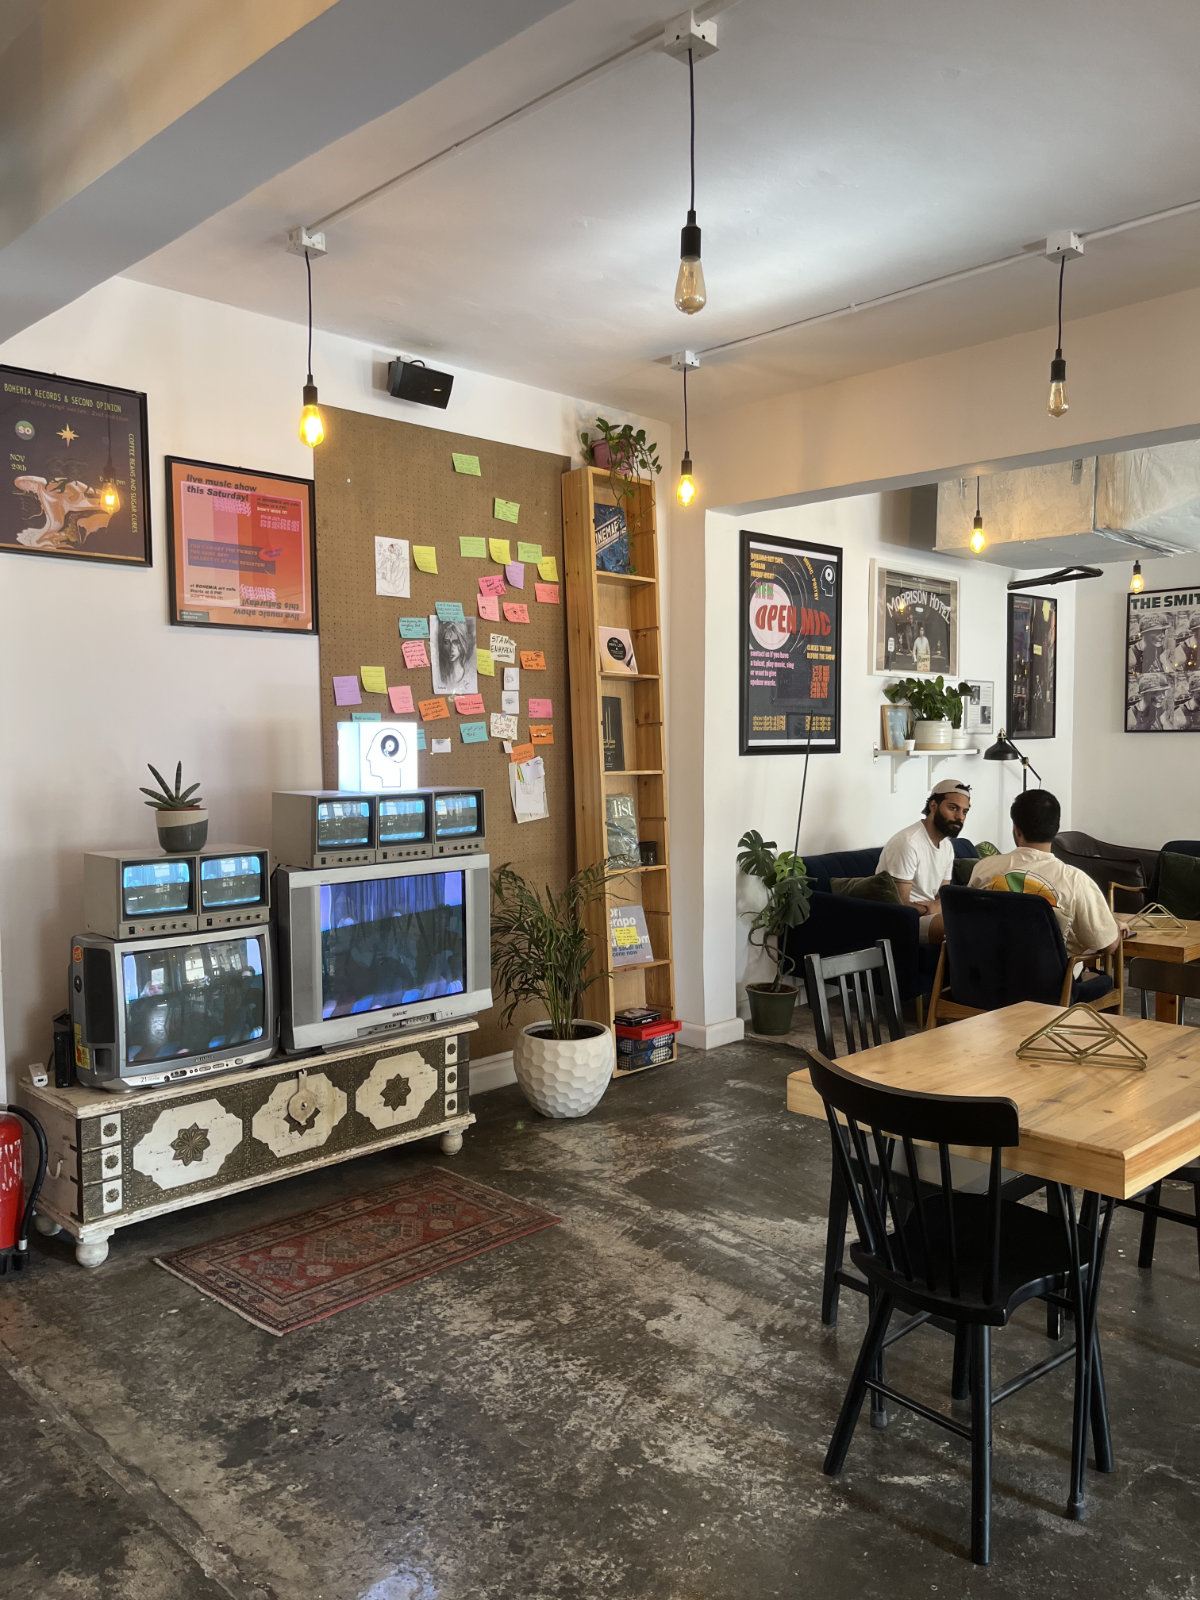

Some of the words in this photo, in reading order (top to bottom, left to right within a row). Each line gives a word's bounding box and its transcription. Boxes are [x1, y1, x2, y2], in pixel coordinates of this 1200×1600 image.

[4, 383, 31, 396] BOHEMIA
[34, 389, 61, 401] RECORDS
[71, 396, 93, 407] SECOND
[96, 401, 121, 413] OPINION
[18, 425, 32, 435] SO
[10, 453, 25, 462] NOV
[187, 474, 202, 483] live
[205, 478, 232, 488] music
[234, 483, 256, 492] show
[187, 485, 204, 494] this
[207, 488, 249, 502] Saturday!
[242, 598, 281, 609] Saturday!
[284, 602, 299, 610] this
[887, 590, 928, 618] MORRISON
[929, 592, 951, 625] HOTEL
[1131, 597, 1161, 610] THE
[233, 608, 256, 616] show
[258, 610, 283, 618] music
[285, 612, 299, 620] live
[755, 604, 797, 635] OPEN
[801, 607, 831, 636] MIC
[613, 799, 633, 817] list
